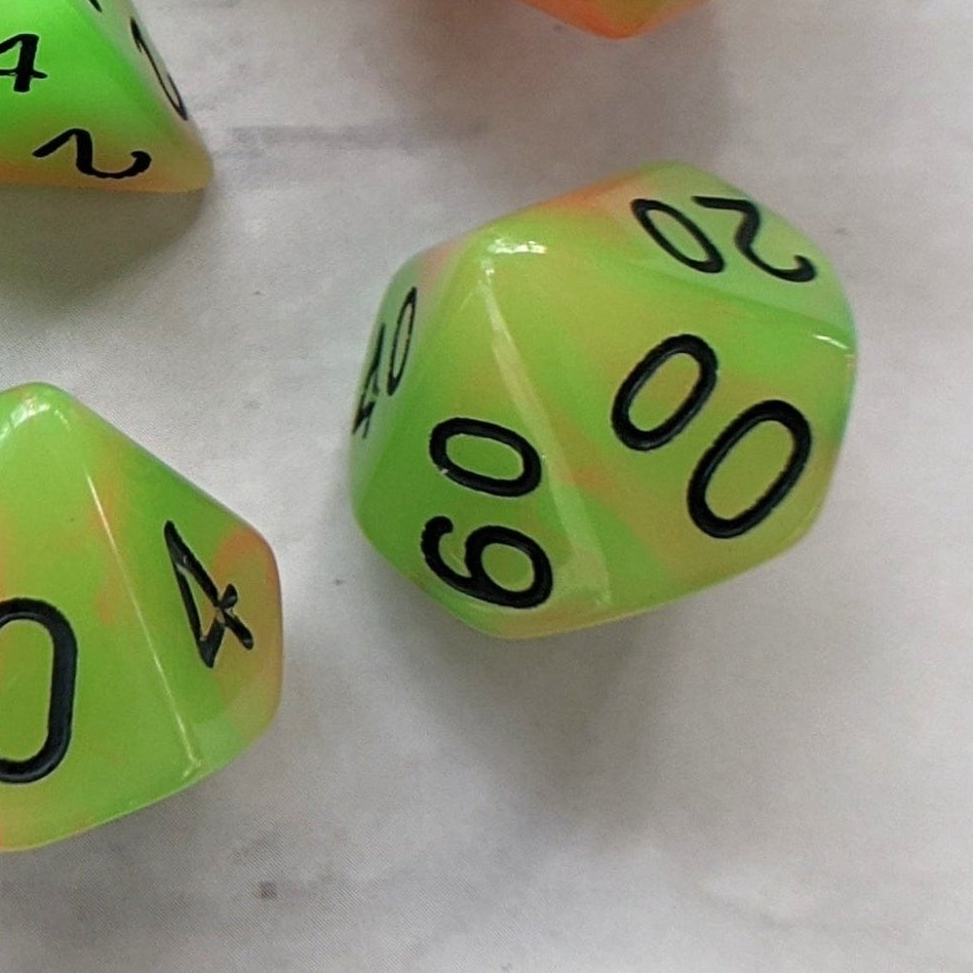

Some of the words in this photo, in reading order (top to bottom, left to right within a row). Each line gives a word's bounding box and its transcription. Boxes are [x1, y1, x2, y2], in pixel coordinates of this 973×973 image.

[30, 127, 153, 181] 2
[630, 195, 817, 283] 20
[610, 333, 814, 540] 00
[419, 416, 554, 610] 60
[163, 520, 256, 669] 4
